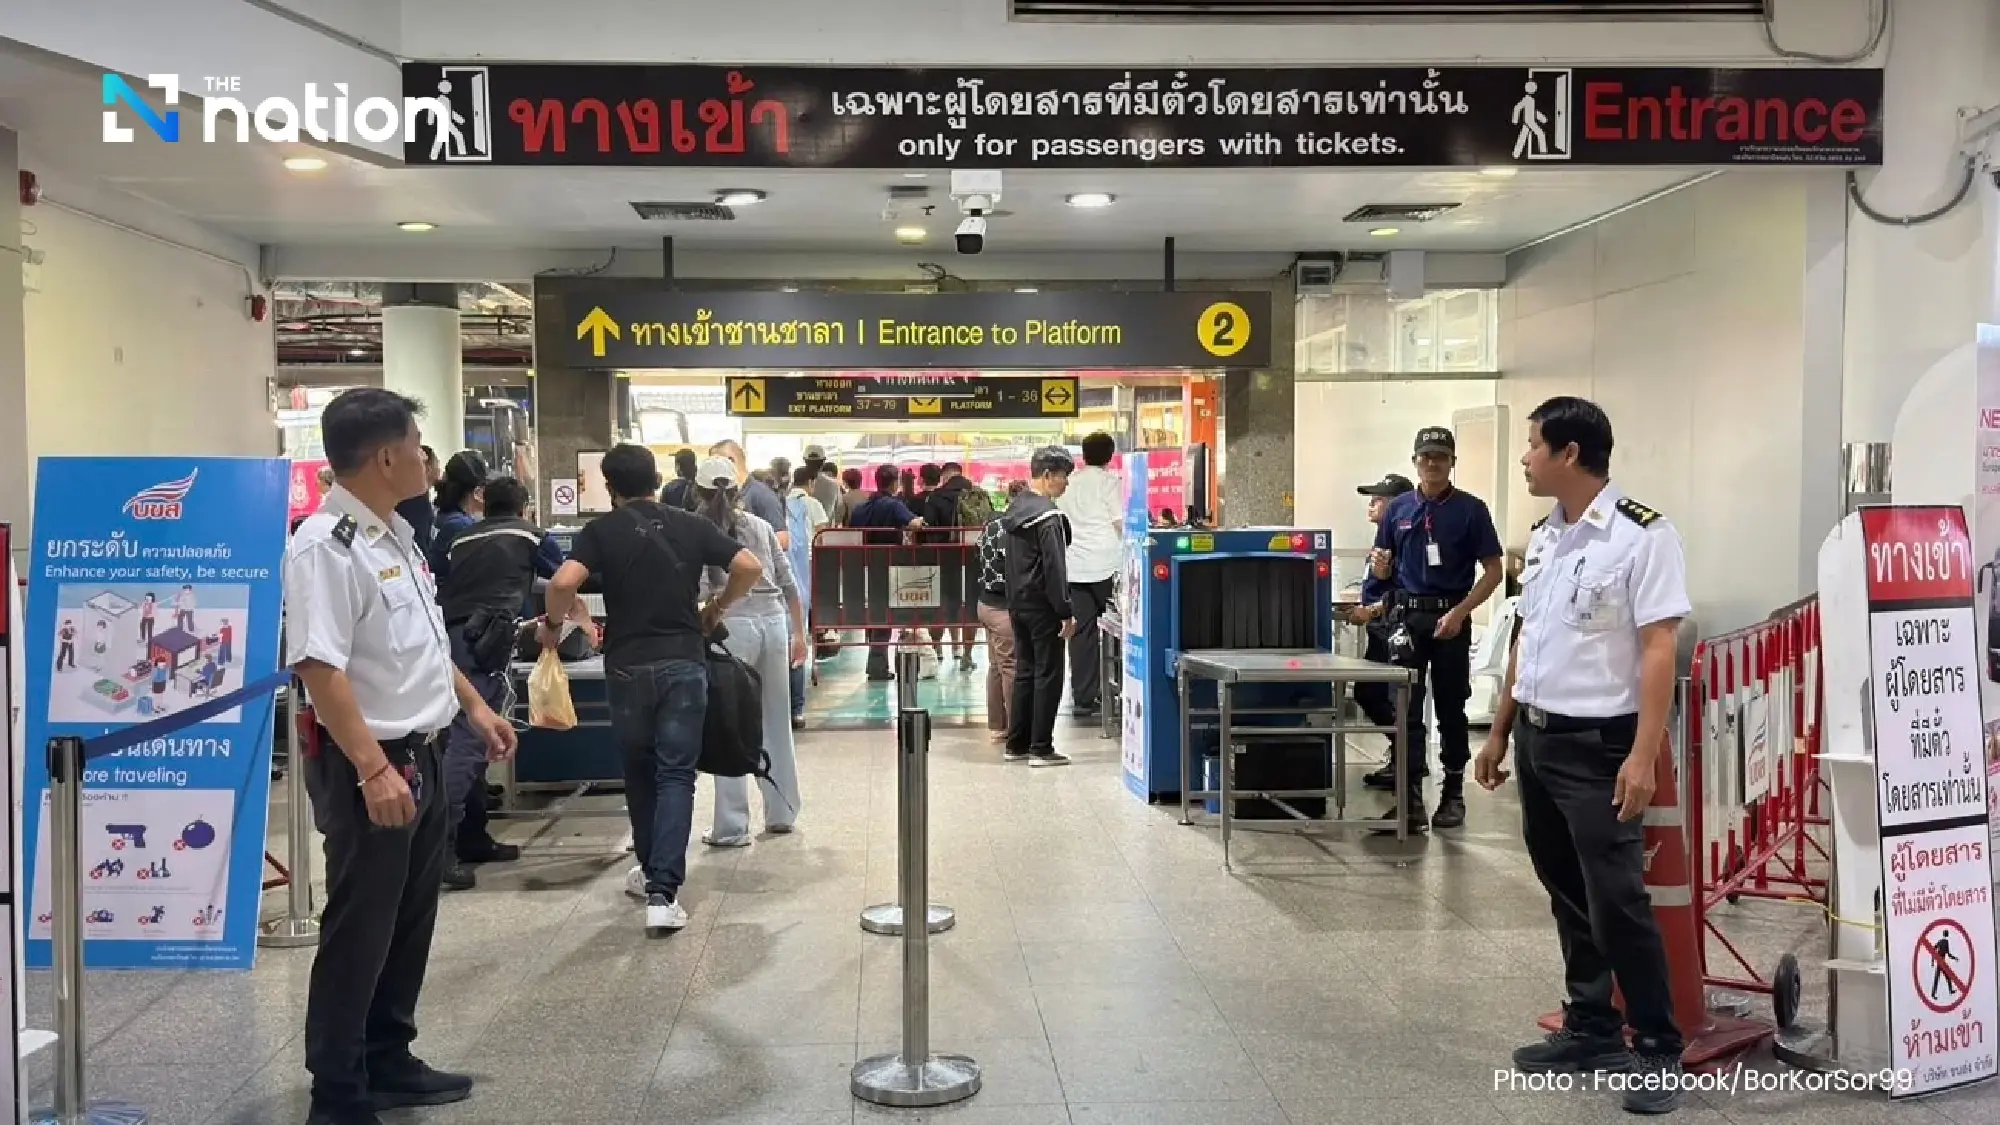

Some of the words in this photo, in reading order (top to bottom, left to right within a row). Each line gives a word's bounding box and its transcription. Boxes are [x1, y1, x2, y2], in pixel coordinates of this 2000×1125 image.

[508, 70, 790, 153] ทางเข้า
[831, 68, 1470, 130] เฉพาะผู้โดยสารที่มีตั๋วโดยสารเท่านั้น
[1584, 82, 1867, 143] Entrance
[898, 133, 962, 161] only
[974, 133, 1018, 156] for
[1031, 138, 1206, 161] passengers
[1219, 132, 1283, 155] with
[1296, 131, 1406, 155] tickets.
[630, 308, 844, 346] ทางเข้าชานชาลา
[878, 319, 983, 346] Entrance
[991, 322, 1018, 346] to
[1024, 318, 1122, 346] Platform
[1212, 310, 1236, 347] 2
[808, 404, 852, 413] PLATFORM
[950, 401, 993, 410] PLATFORM
[133, 501, 182, 519] บขส
[47, 531, 139, 558] ยกระดับ
[1871, 519, 1967, 583] ทางเข้า
[45, 566, 106, 579] Enhance
[108, 567, 141, 581] your
[145, 565, 193, 580] safety,
[197, 565, 216, 578] be
[221, 568, 269, 579] secure
[1895, 618, 1951, 647] เฉพาะ
[1886, 656, 1966, 712] ผู้โดยสาร
[1910, 705, 1951, 760] ที่มีตั๋ว
[114, 766, 188, 786] traveling
[1882, 751, 1981, 814] โดยสารเท่านั้น
[1890, 841, 1983, 883] ผู้โดยสาร
[1892, 882, 1988, 917] ที่ไม่มีตั๋วโดยสาร
[1902, 1007, 1984, 1060] ห้ามเข้า
